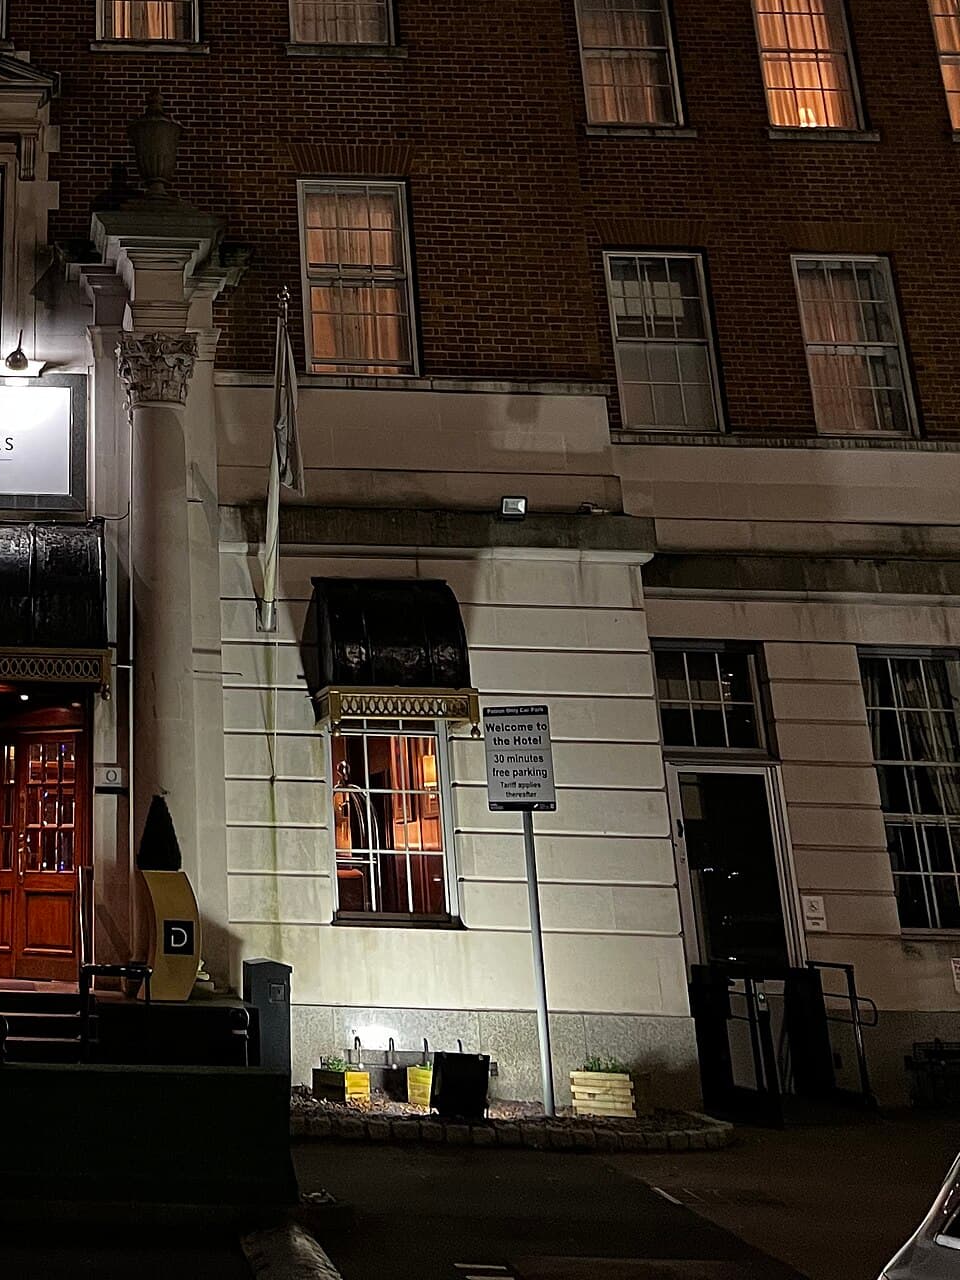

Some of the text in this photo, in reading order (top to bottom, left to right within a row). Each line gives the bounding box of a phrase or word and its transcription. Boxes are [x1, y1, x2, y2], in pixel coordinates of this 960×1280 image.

[485, 721, 548, 732] Welcome to
[493, 735, 542, 746] the Hotel
[494, 754, 544, 763] 30 minutes
[492, 767, 548, 779] free parking
[500, 781, 542, 789] Tariff applies
[171, 927, 188, 947] D
